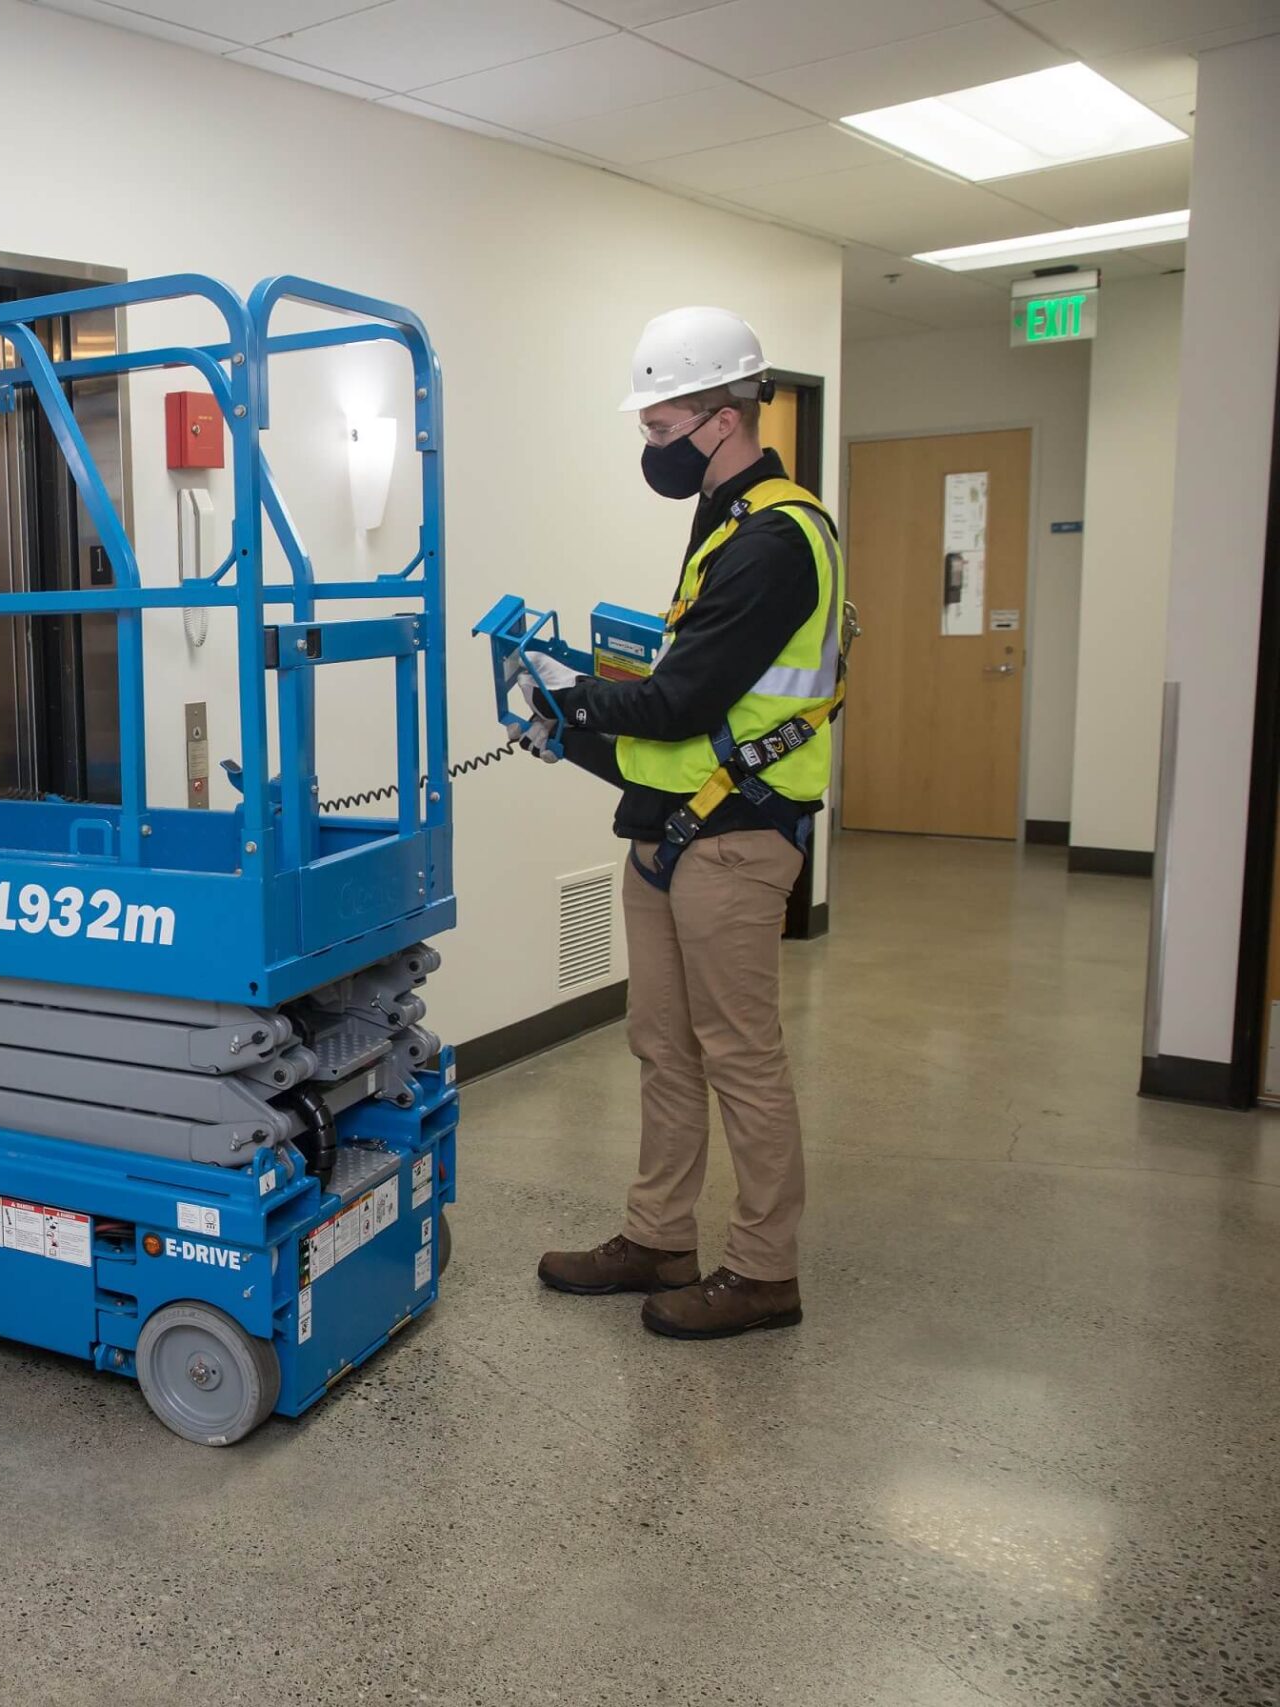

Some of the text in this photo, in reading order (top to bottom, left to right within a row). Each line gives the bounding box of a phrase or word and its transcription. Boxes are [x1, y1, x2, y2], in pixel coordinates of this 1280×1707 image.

[1026, 295, 1087, 342] EXIT
[96, 548, 104, 572] 1
[165, 1238, 241, 1271] E-DRIVE
